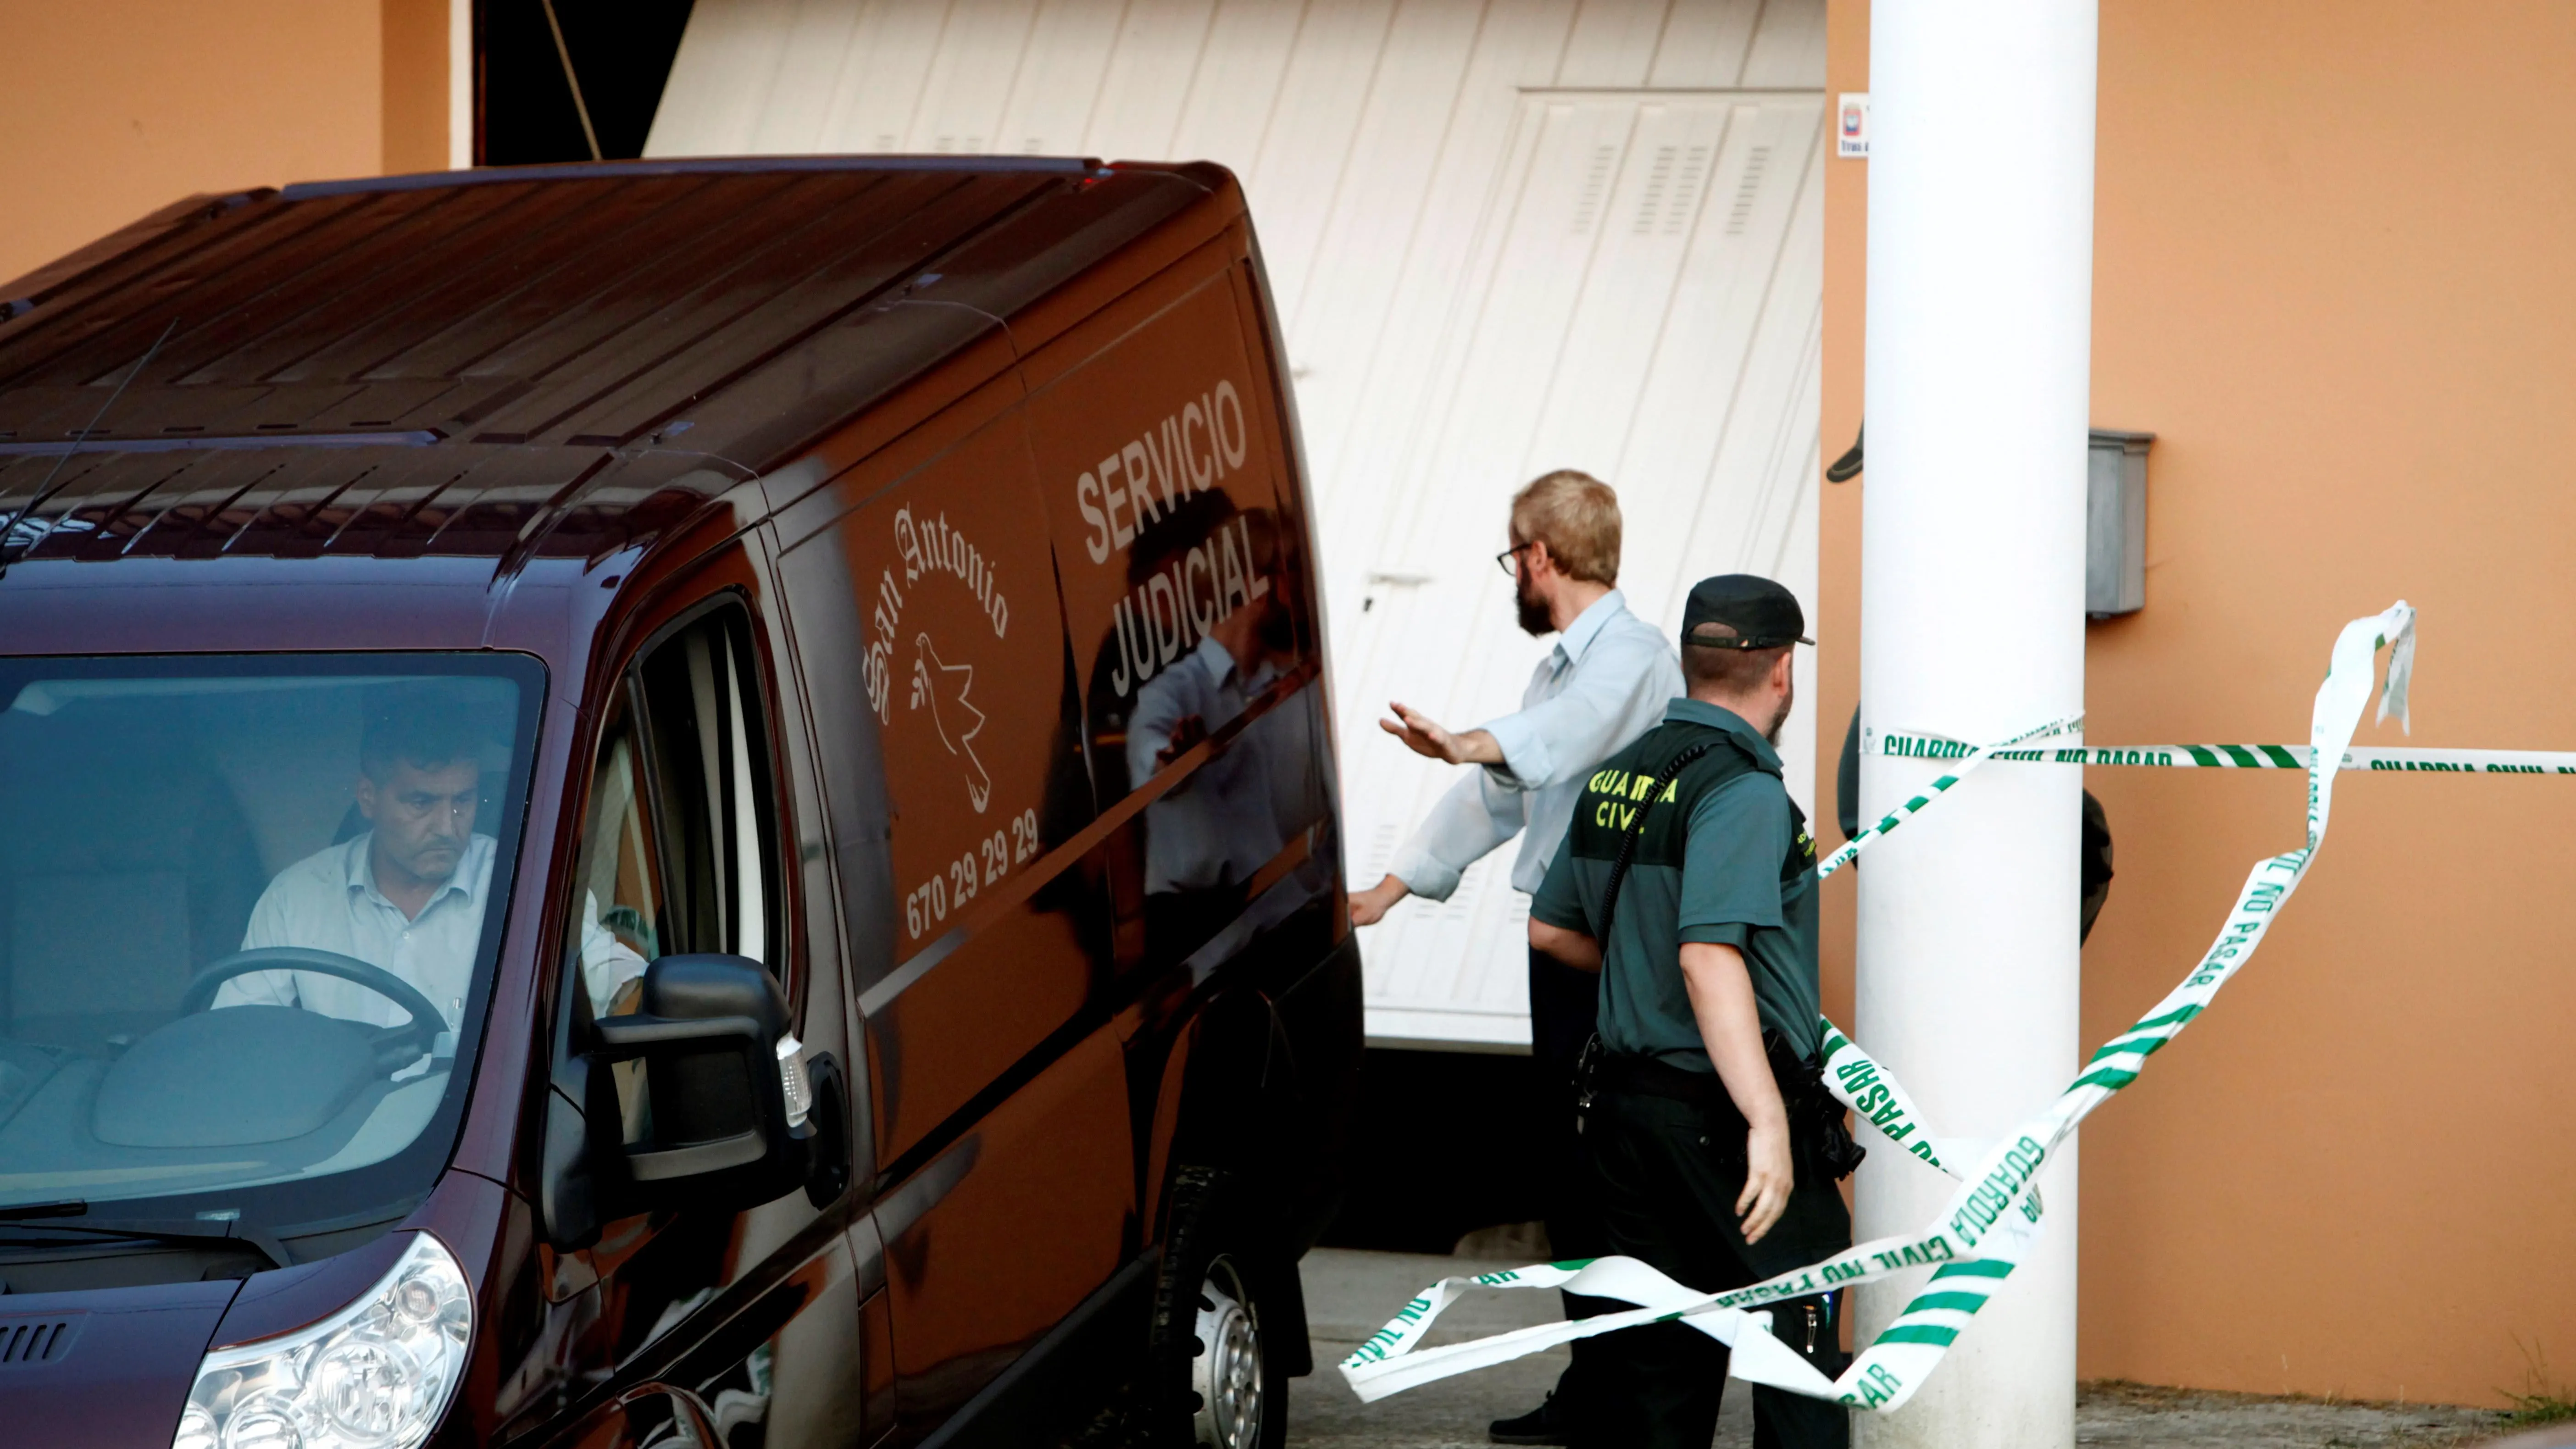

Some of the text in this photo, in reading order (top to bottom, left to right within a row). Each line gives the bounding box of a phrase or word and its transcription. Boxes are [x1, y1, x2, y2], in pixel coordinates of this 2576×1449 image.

[1077, 380, 1246, 565] SERVICIO
[862, 501, 1009, 726] San Antonio
[1112, 515, 1269, 698] JUDICIAL
[907, 808, 1038, 939] 670 29 29 29
[2183, 922, 2260, 989] PASAR
[1836, 1060, 1916, 1141] PASAR
[1871, 1235, 1955, 1270] CIVIL
[1949, 1136, 2044, 1248] GUARDIA
